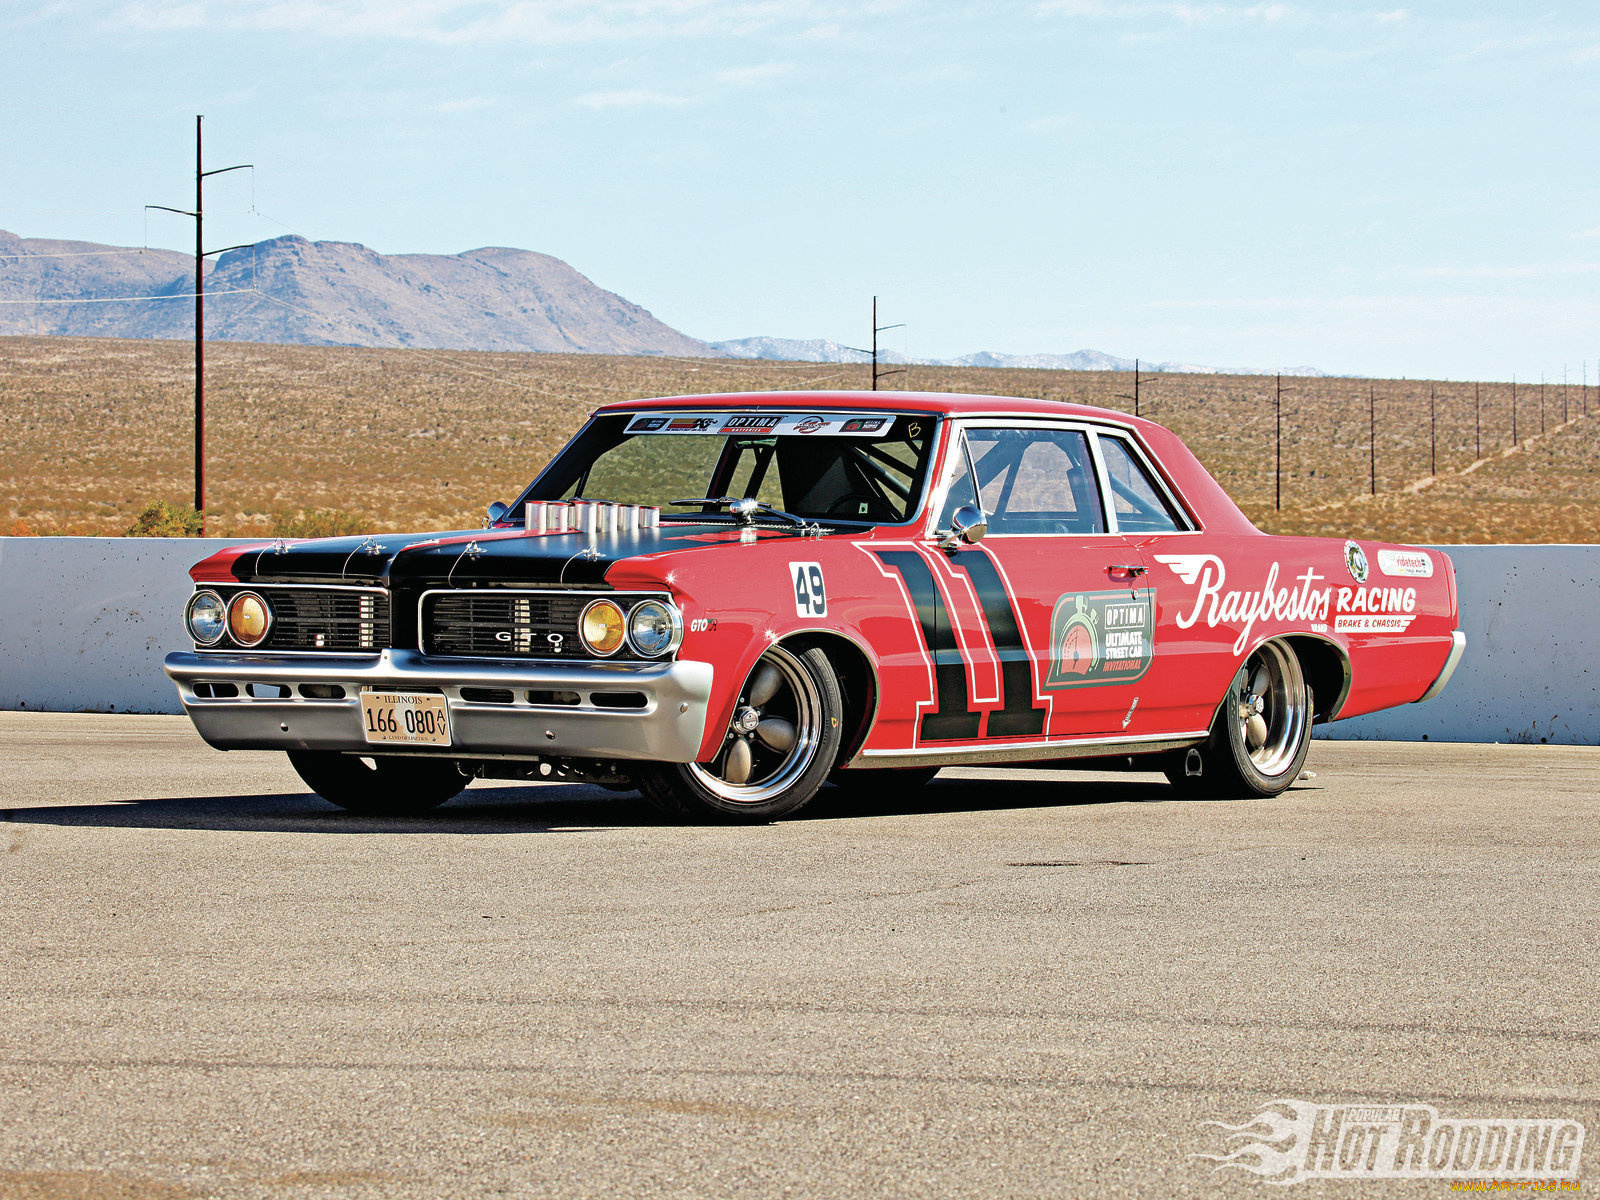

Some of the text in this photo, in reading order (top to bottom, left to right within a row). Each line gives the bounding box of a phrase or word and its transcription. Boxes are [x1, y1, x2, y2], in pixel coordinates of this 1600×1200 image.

[727, 417, 778, 427] OPTIMA
[908, 417, 921, 438] B
[1396, 555, 1422, 567] ridetech
[796, 566, 825, 614] 49
[1153, 554, 1330, 656] Raybestos
[1336, 586, 1417, 613] RACING
[1106, 607, 1143, 626] OPTIMA
[1338, 619, 1402, 628] BRAKE & CHASSIS
[691, 618, 709, 632] GTO
[495, 631, 564, 643] GTO
[1105, 631, 1143, 647] ULTIMATE
[1105, 645, 1143, 660] STREET CAR
[1103, 659, 1142, 672] INVITATIONAL
[384, 695, 423, 704] ILLINOIS
[367, 708, 397, 733] 166
[405, 709, 436, 734] 080
